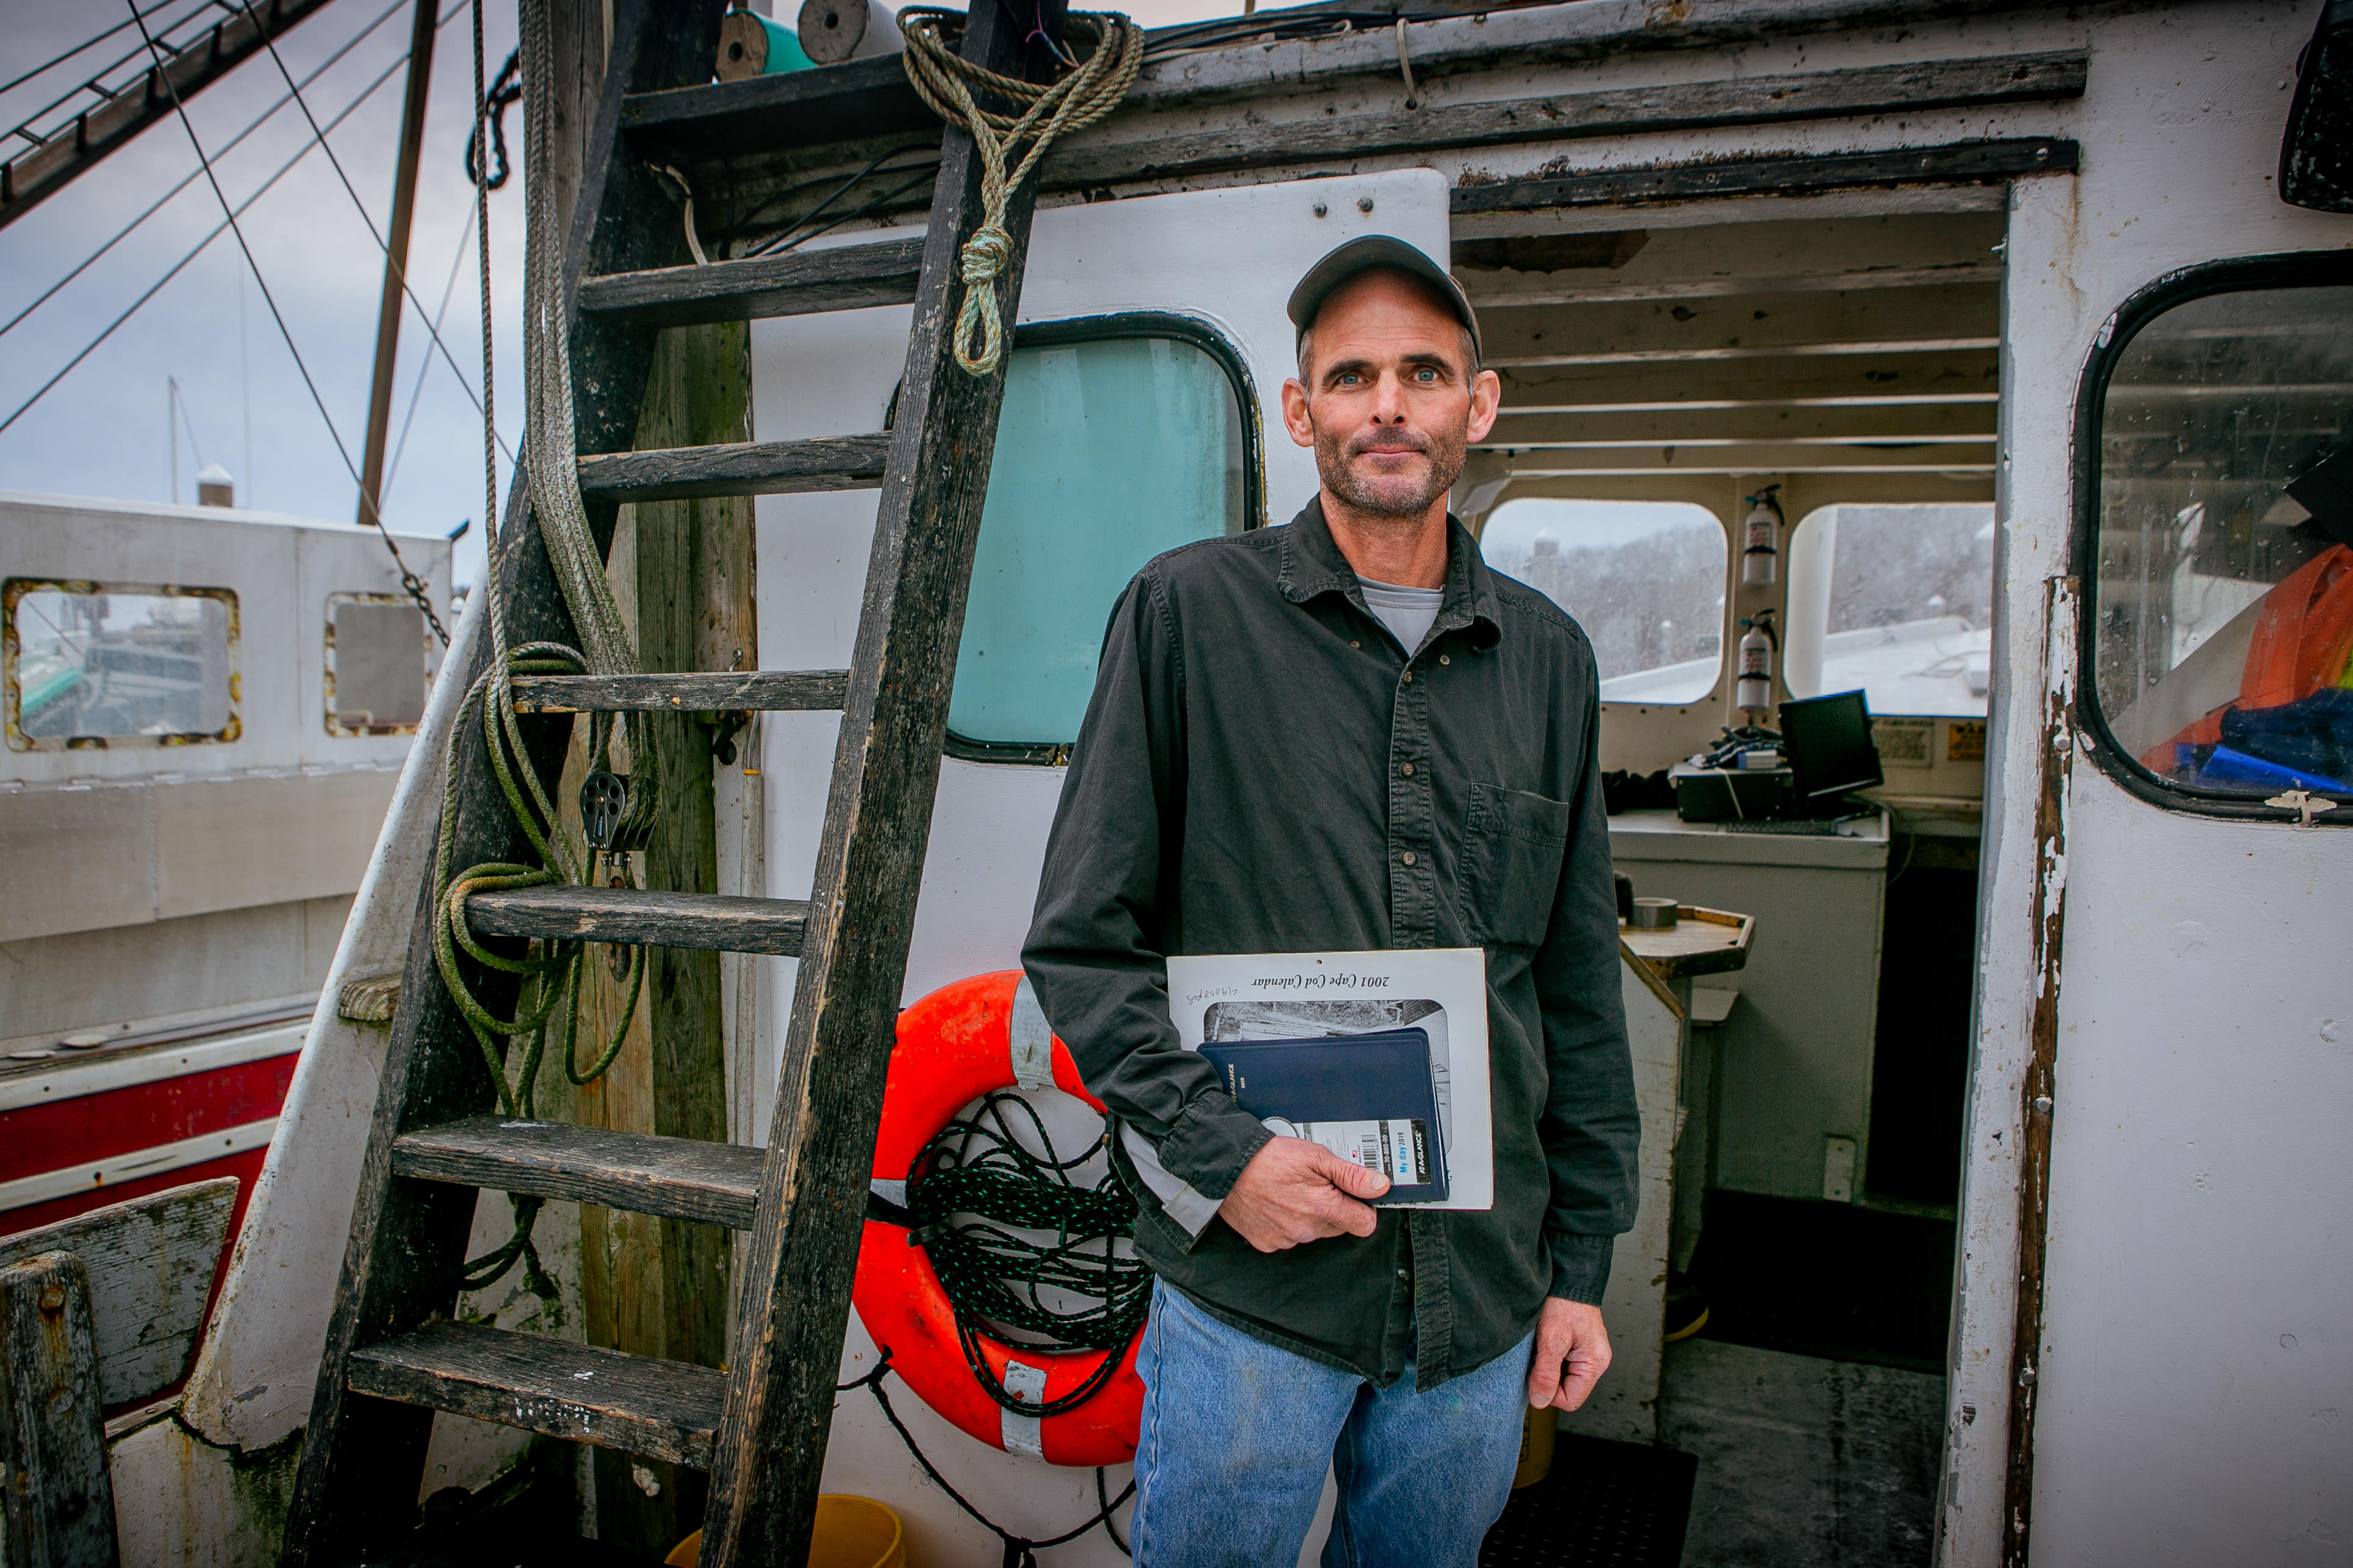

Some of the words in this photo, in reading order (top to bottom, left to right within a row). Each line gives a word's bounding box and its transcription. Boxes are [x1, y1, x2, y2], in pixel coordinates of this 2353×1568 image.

[1251, 975, 1302, 990] Calendar
[1304, 974, 1326, 989] Cod
[1329, 973, 1357, 989] Cape
[1361, 976, 1390, 987] 2001
[1382, 1134, 1390, 1164] 70-800-00
[1398, 1147, 1407, 1160] day
[1399, 1162, 1409, 1173] My
